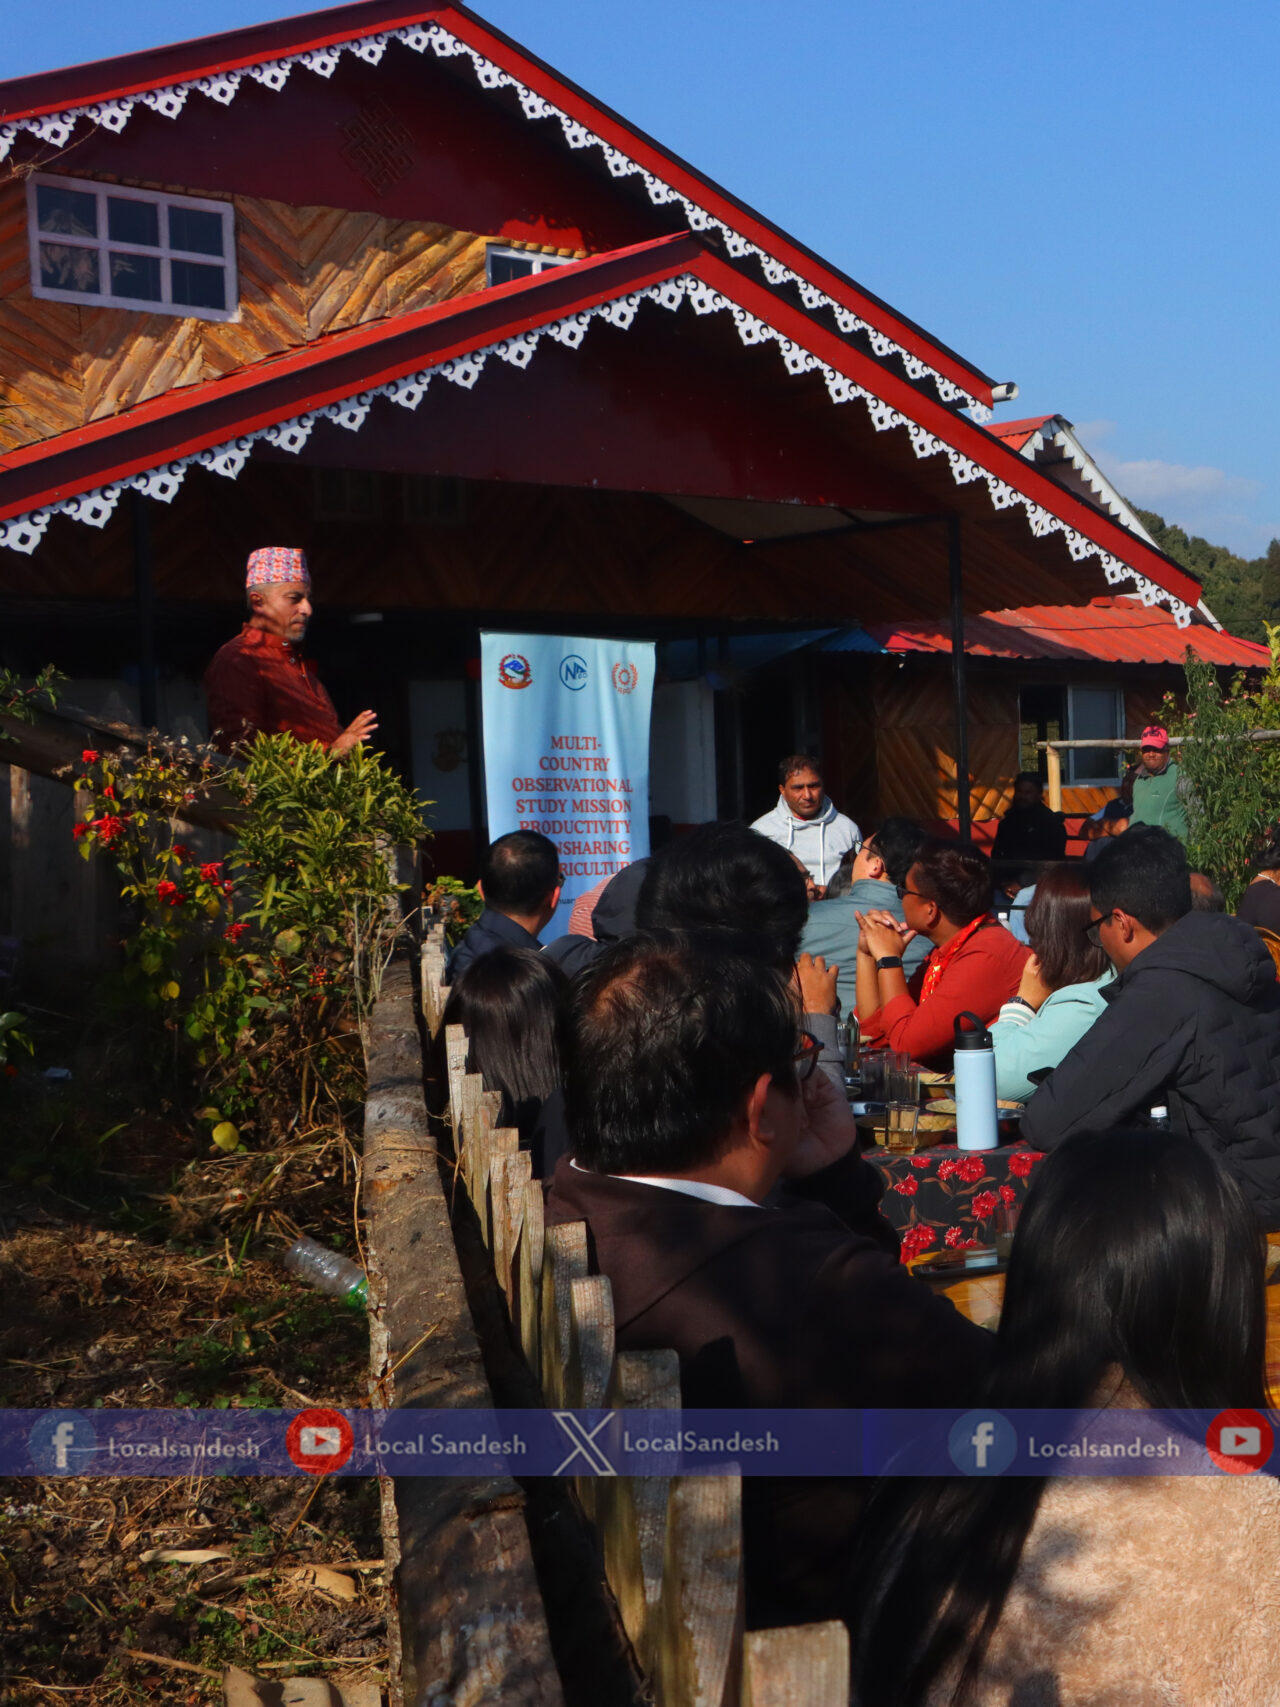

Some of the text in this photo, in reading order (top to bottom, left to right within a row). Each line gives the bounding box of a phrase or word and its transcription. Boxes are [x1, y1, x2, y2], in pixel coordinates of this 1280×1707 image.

[551, 735, 602, 750] MULTI-
[539, 757, 610, 771] COUNTRY
[512, 778, 633, 793] OBSERVATIONAL
[516, 799, 632, 814] STUDY MISSION
[519, 820, 631, 835] PRODUCTIVITY
